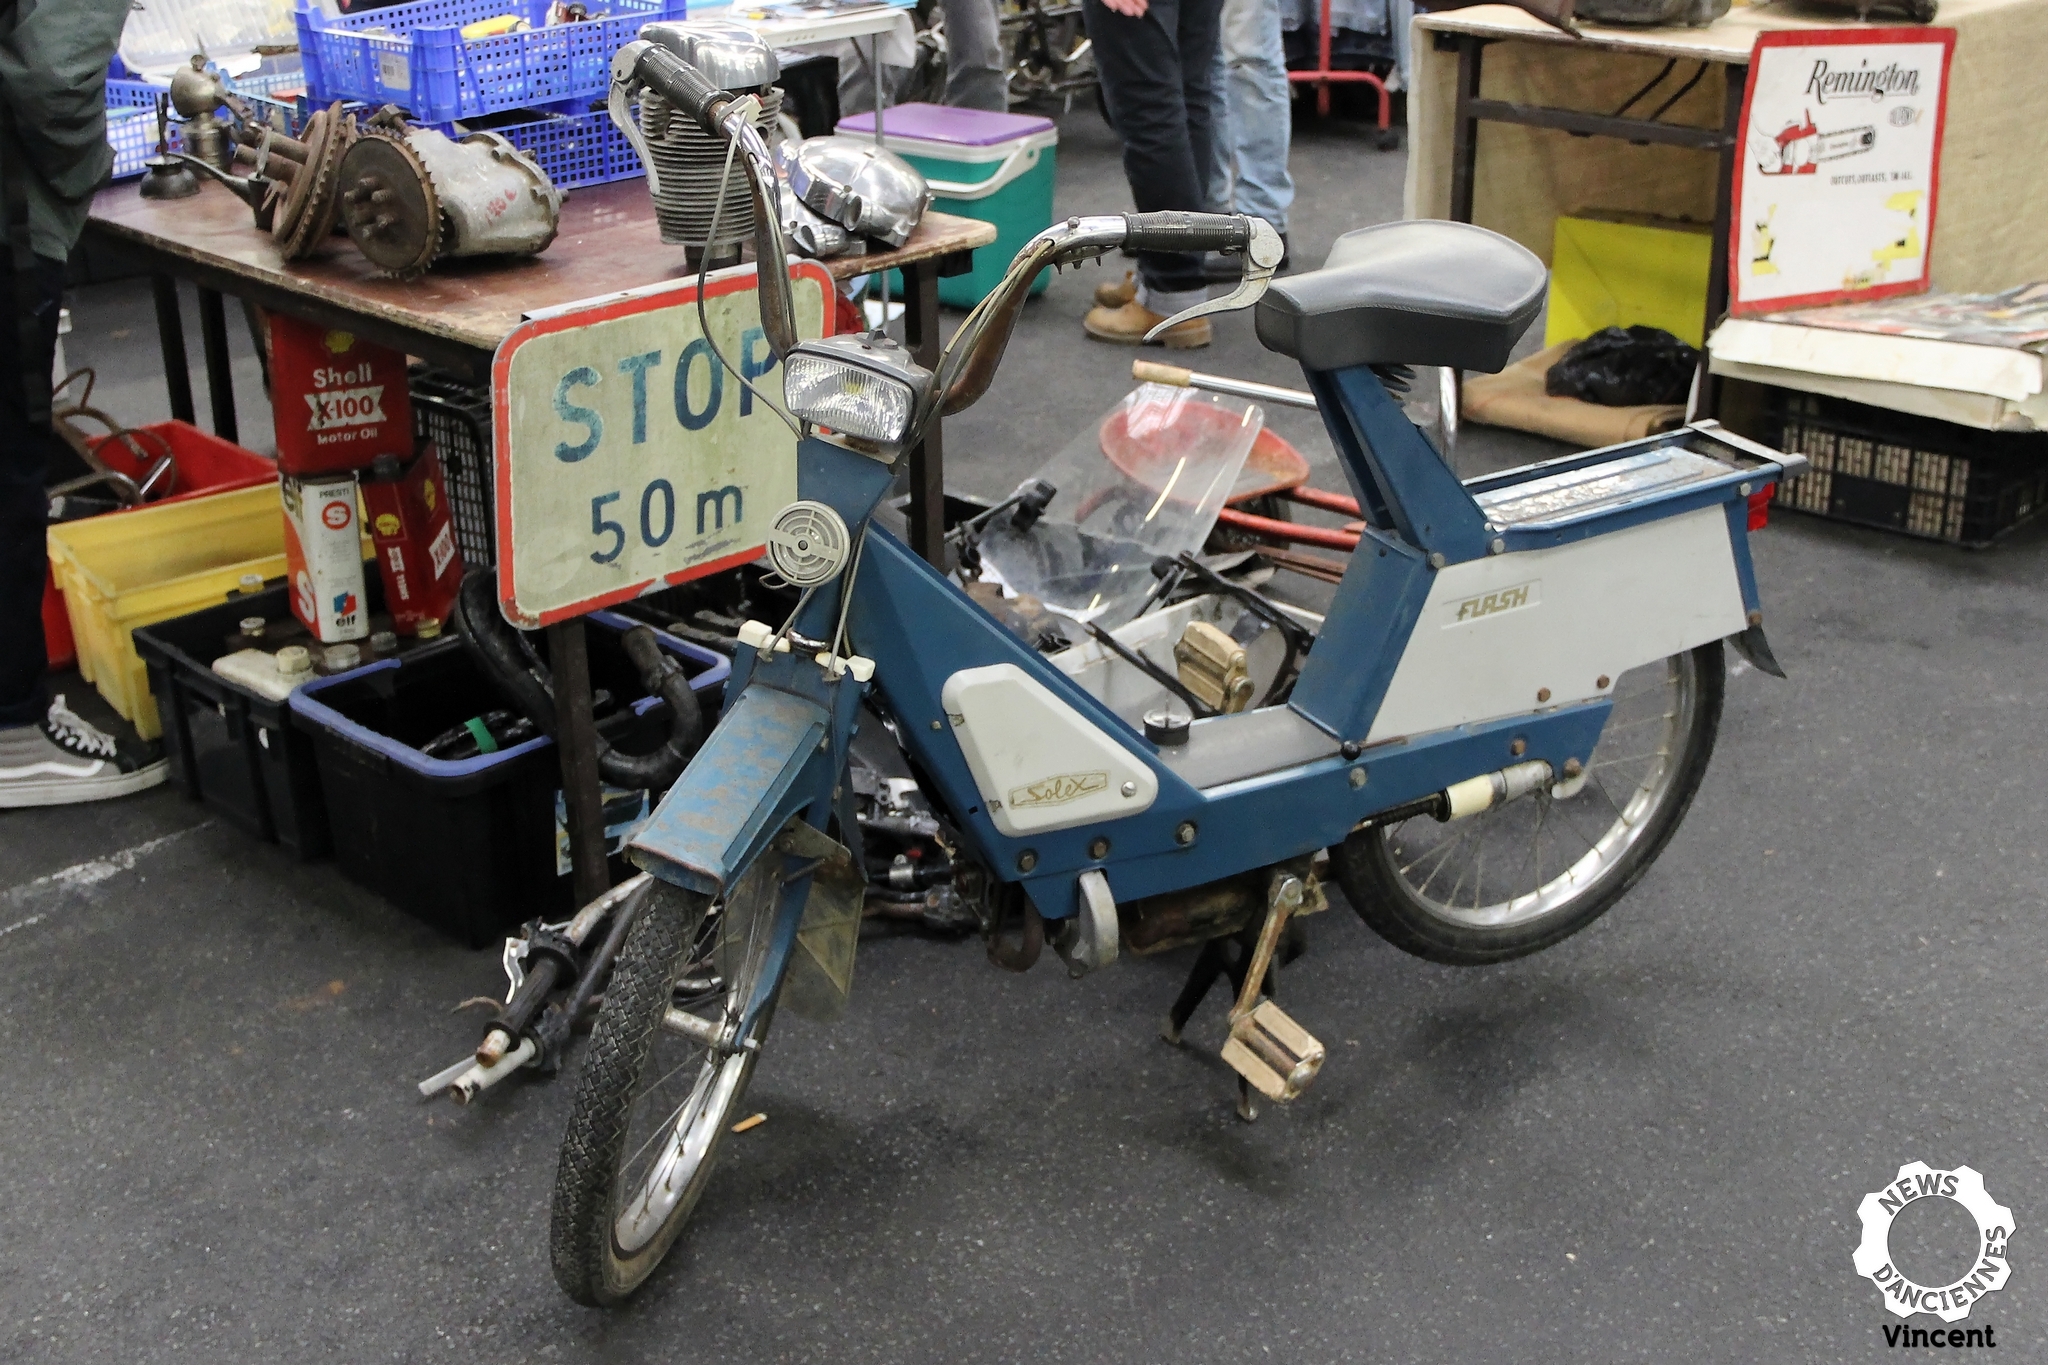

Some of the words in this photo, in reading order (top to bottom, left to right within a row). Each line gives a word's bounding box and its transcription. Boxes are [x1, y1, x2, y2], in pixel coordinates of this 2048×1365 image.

[1803, 59, 1918, 105] Remington
[313, 361, 372, 388] Shell
[554, 326, 780, 463] STOP
[317, 431, 357, 445] Motor
[360, 428, 378, 439] Oil
[590, 478, 675, 564] 50
[696, 485, 743, 535] m
[1457, 585, 1529, 621] FLASH
[336, 615, 356, 627] elf
[1021, 777, 1099, 803] Solex
